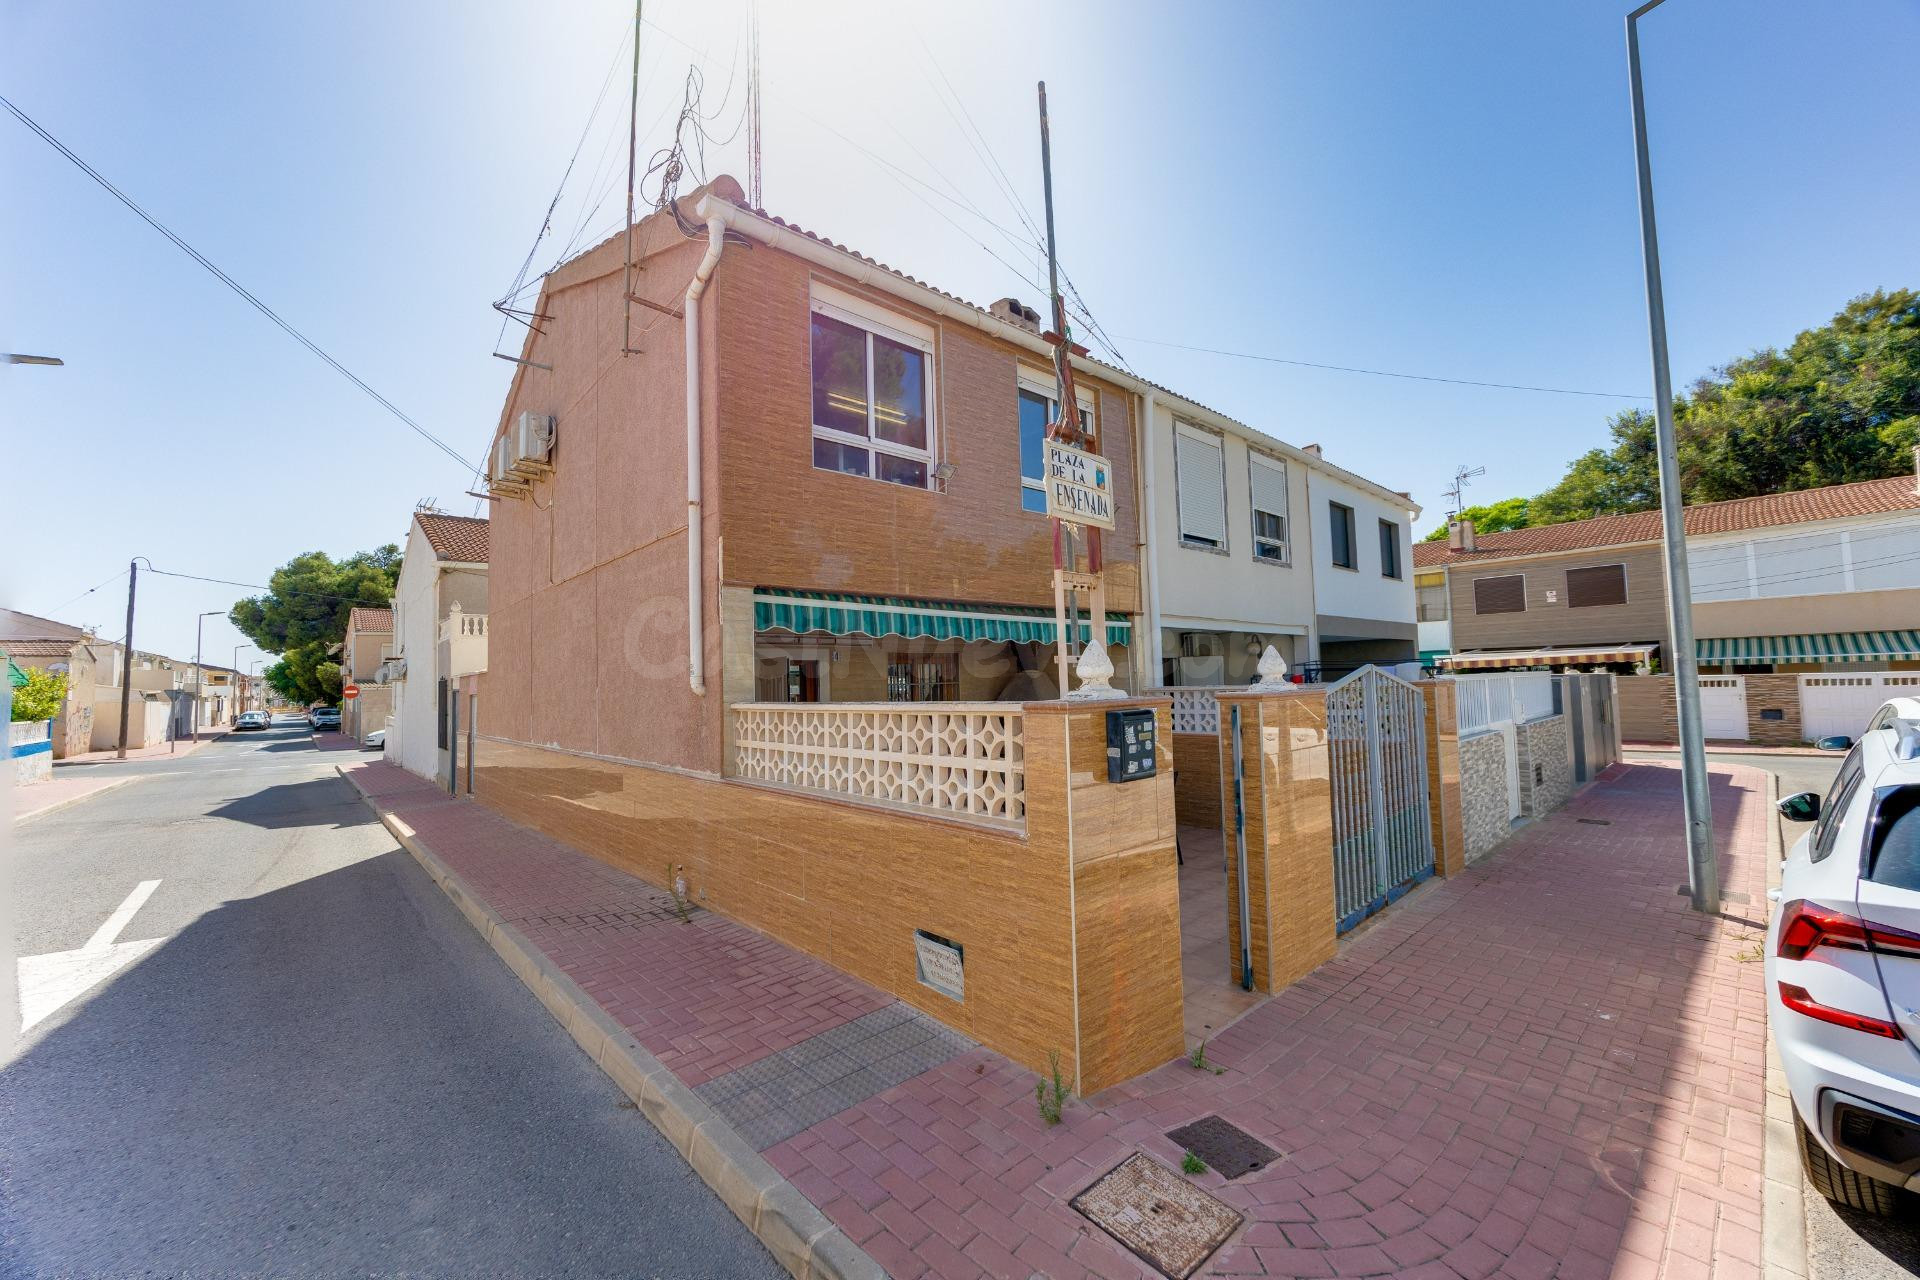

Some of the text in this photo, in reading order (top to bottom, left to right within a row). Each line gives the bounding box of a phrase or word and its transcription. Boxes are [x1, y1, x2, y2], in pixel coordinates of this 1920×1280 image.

[1051, 449, 1085, 469] PLAZA
[1052, 464, 1086, 484] DE LA
[1056, 483, 1109, 517] ENSENADA
